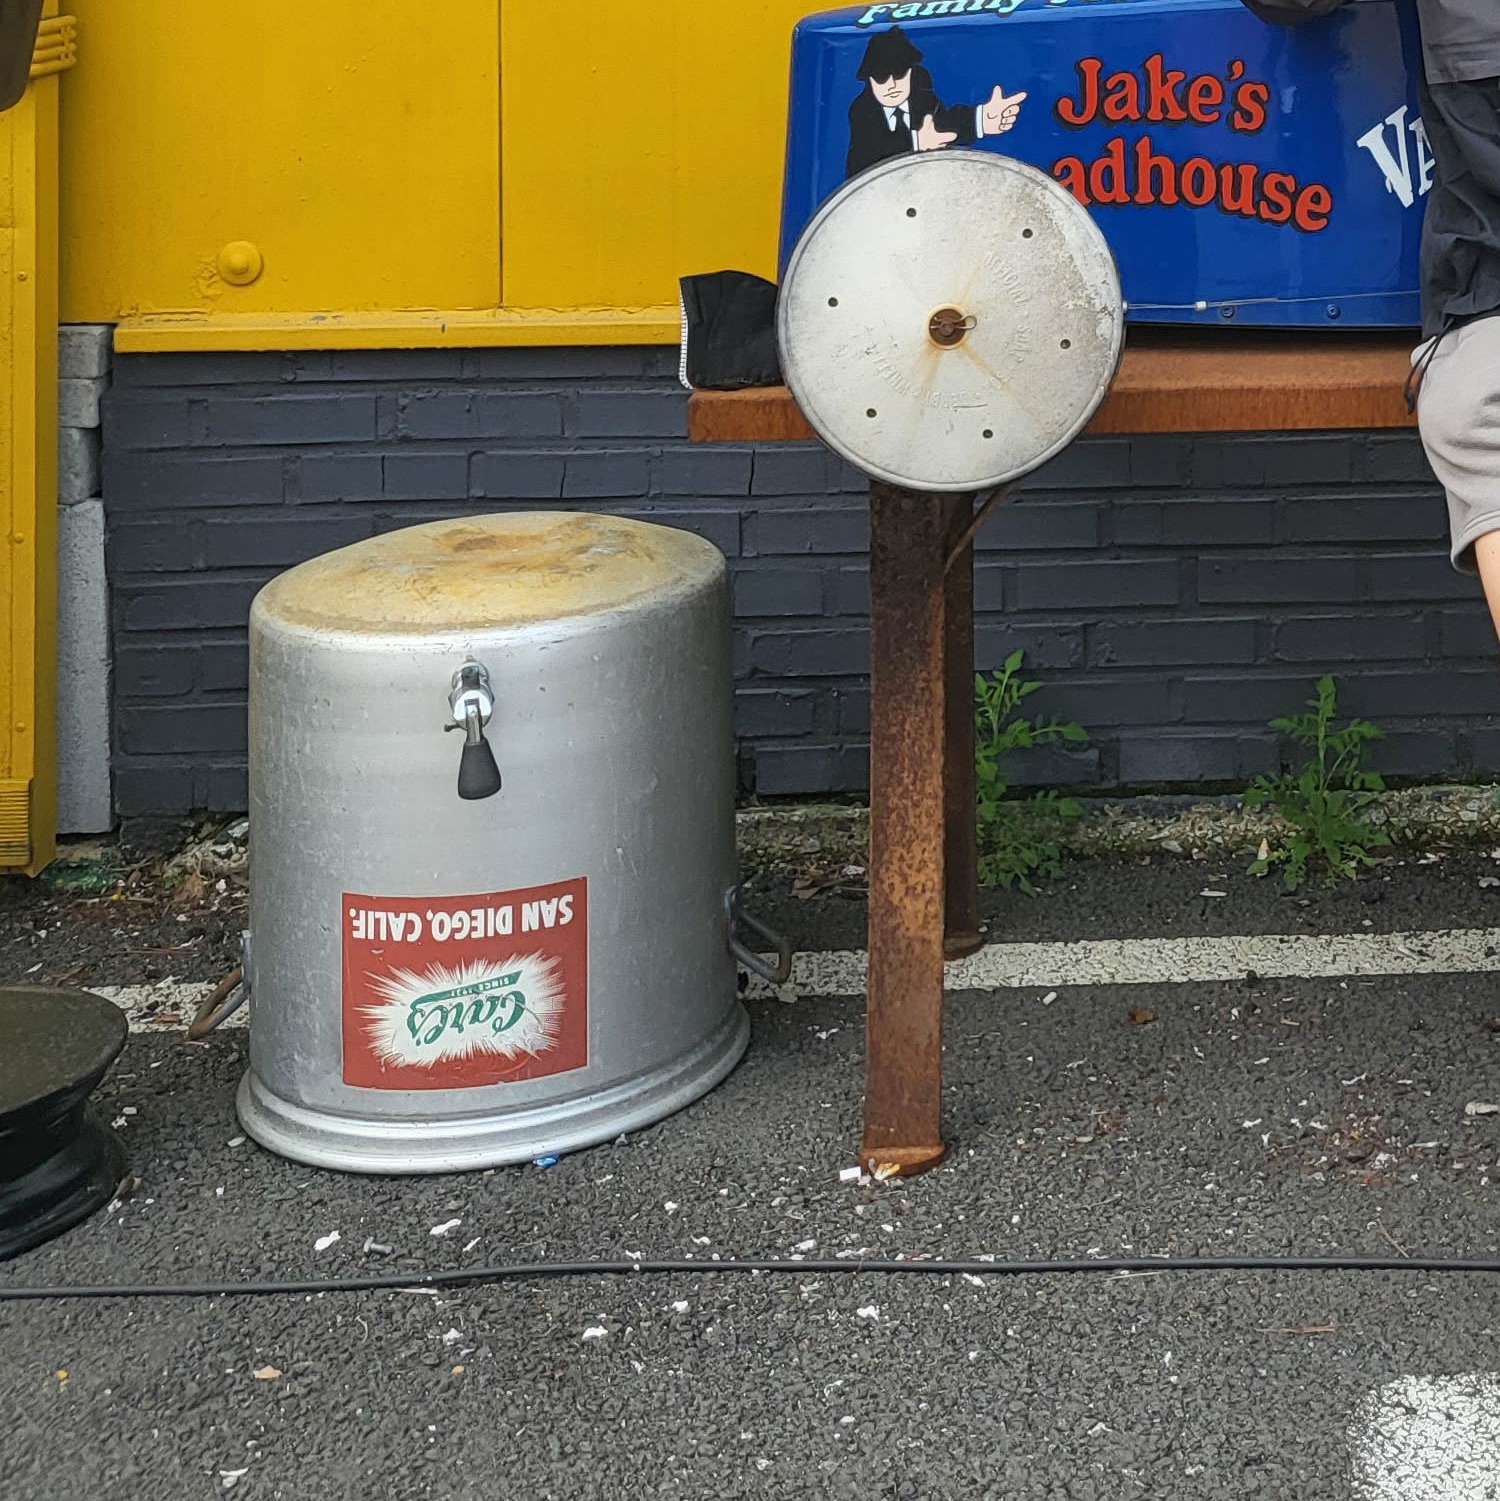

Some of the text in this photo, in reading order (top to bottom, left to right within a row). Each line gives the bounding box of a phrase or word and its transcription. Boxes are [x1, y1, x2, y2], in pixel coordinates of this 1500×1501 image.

[1058, 52, 1271, 133] Jake's
[1052, 136, 1333, 233] adhouse
[1356, 104, 1437, 209] VA
[349, 894, 574, 943] SAN DIEGO, CALIF.
[478, 976, 510, 990] SINCE
[407, 990, 526, 1047] Carl's
